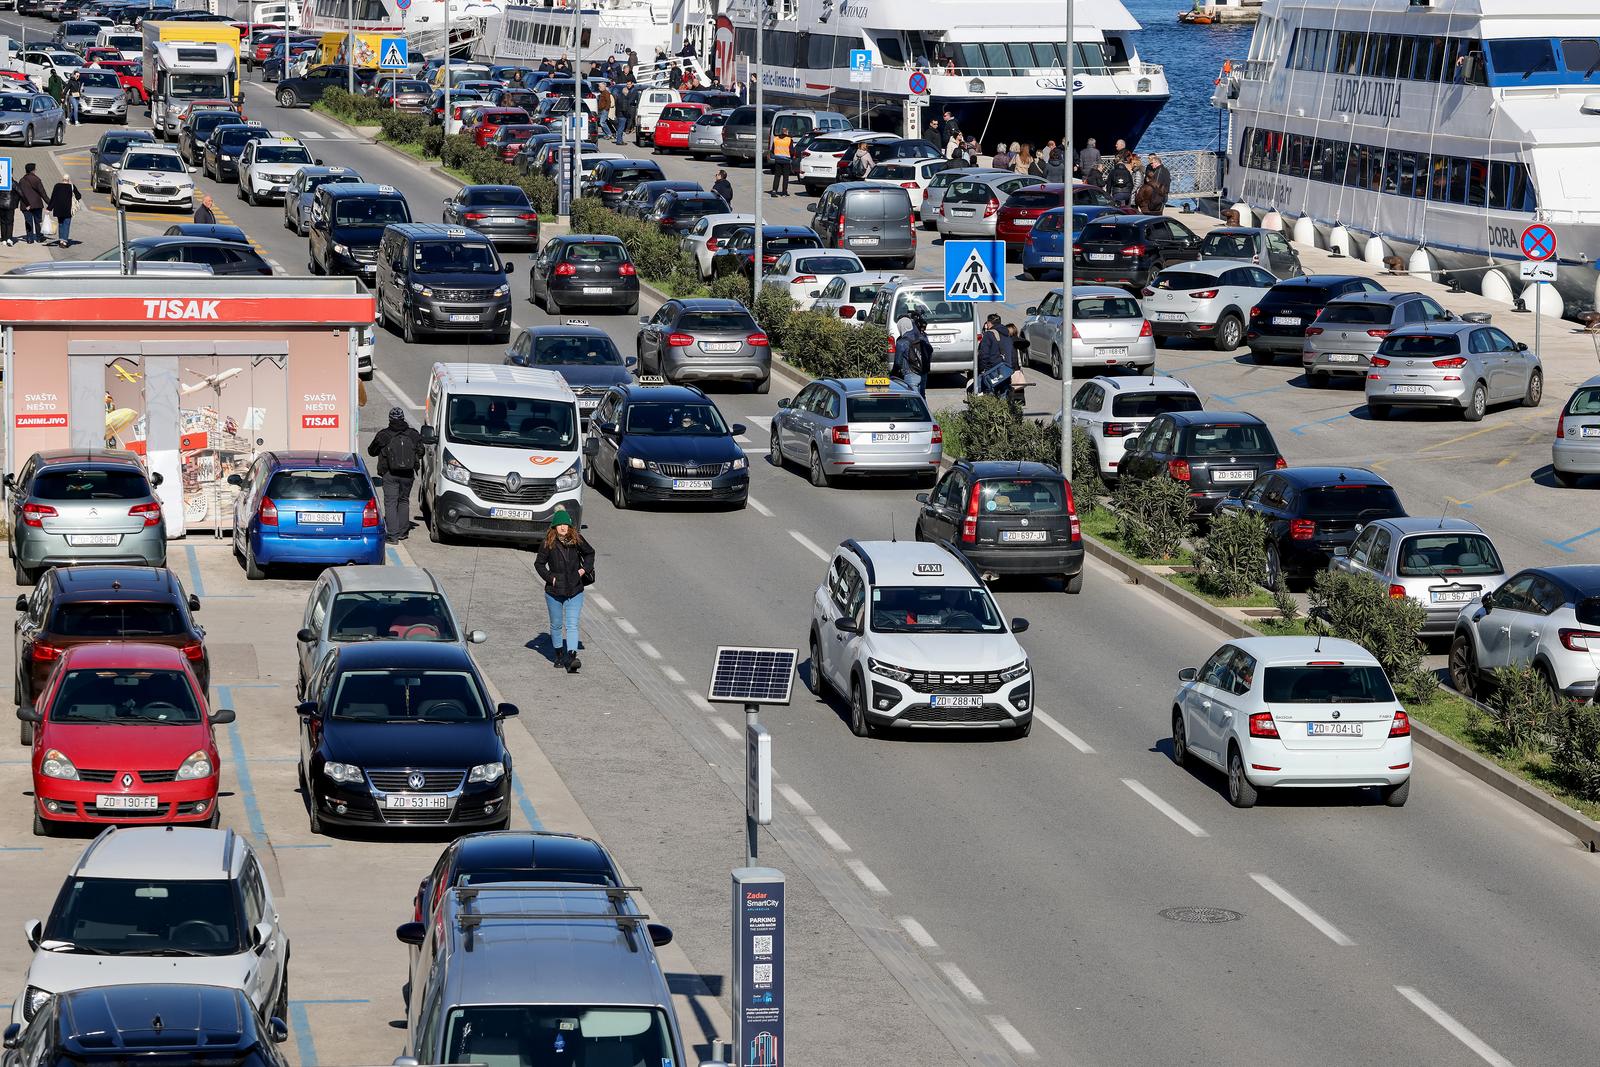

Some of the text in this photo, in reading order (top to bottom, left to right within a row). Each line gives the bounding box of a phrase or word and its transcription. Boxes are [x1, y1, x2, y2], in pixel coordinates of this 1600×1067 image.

[857, 54, 868, 66] P
[1330, 78, 1402, 127] JADROLINIJA
[1488, 226, 1519, 249] DORA
[143, 300, 221, 319] TISAK
[25, 393, 58, 402] SVAŠTA
[303, 392, 337, 402] SVAŠTA
[26, 402, 56, 411] NEŠTO
[305, 402, 336, 411] NEŠTO
[17, 417, 66, 425] ZANIMLJIVO
[304, 417, 336, 426] TISAK
[876, 433, 884, 441] ZD
[677, 480, 686, 488] ZD
[303, 514, 313, 522] ZD
[1007, 532, 1017, 540] ZD
[919, 564, 941, 572] TAXI
[936, 697, 982, 706] ZD 288-NC
[1313, 724, 1362, 734] ZD 704-LG
[103, 797, 157, 808] ZD 190-FE
[393, 797, 446, 808] ZD 531-HB
[746, 892, 768, 900] Zadar
[747, 899, 779, 908] SmartCity
